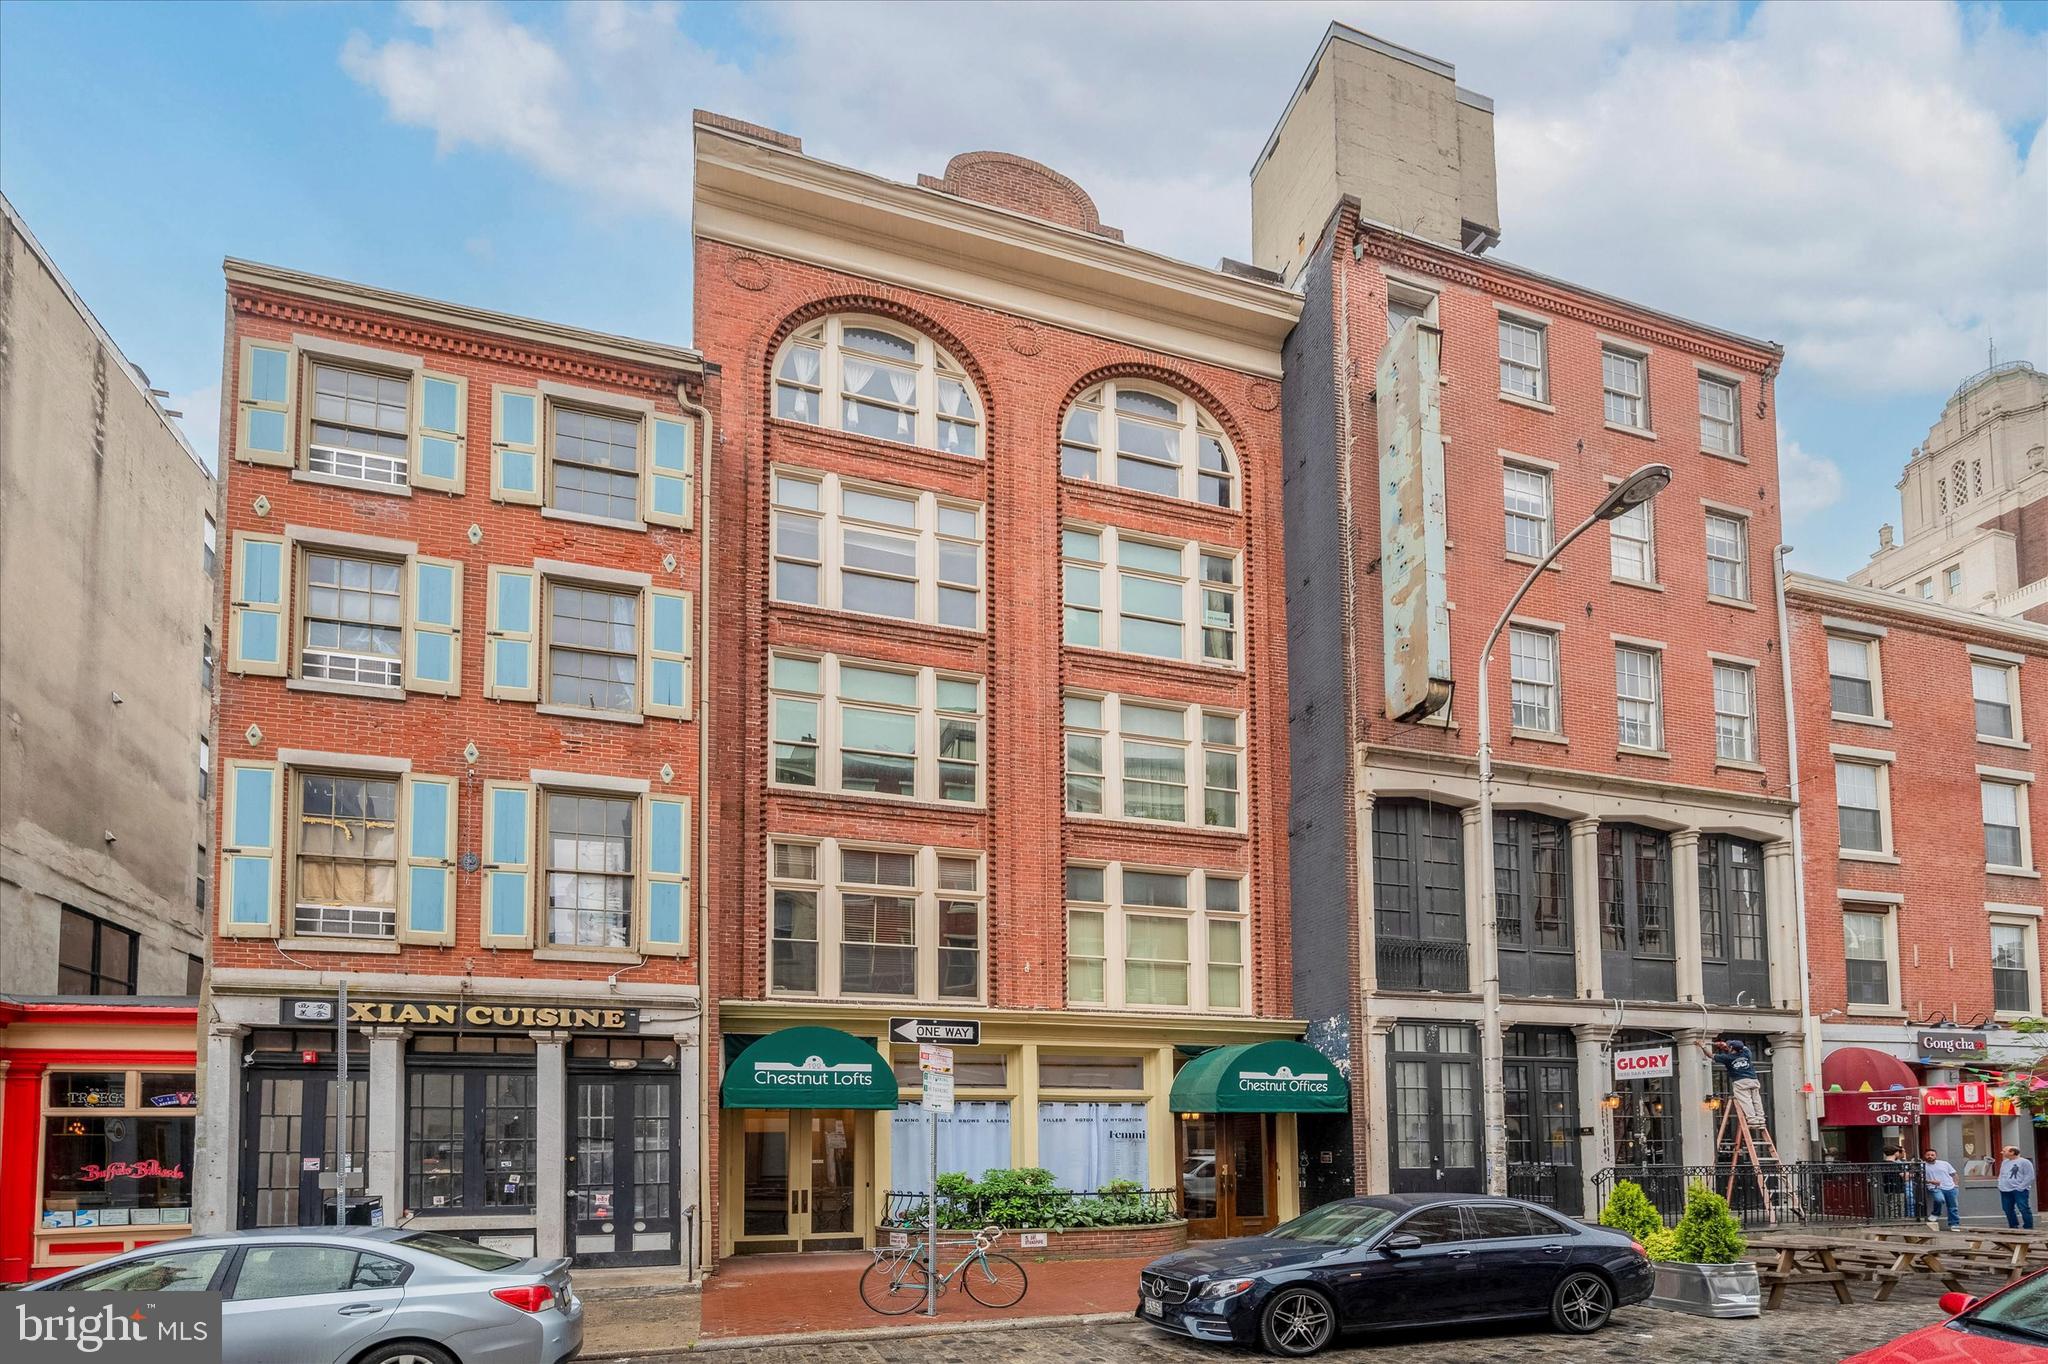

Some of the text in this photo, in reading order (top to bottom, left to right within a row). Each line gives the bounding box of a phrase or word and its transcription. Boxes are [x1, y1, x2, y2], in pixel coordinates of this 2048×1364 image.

[348, 1002, 626, 1029] XIAN CUISINE
[917, 1027, 969, 1037] ONE WAY
[1923, 1036, 1975, 1052] Gong cha
[1617, 1055, 1669, 1070] GLORY
[754, 1071, 872, 1086] Chestnut Lofts
[1239, 1080, 1328, 1092] Chestnut Offices
[1927, 1096, 1955, 1106] Grand
[1868, 1102, 1897, 1112] The
[1877, 1114, 1908, 1123] Olde
[1109, 1130, 1146, 1139] Femmi
